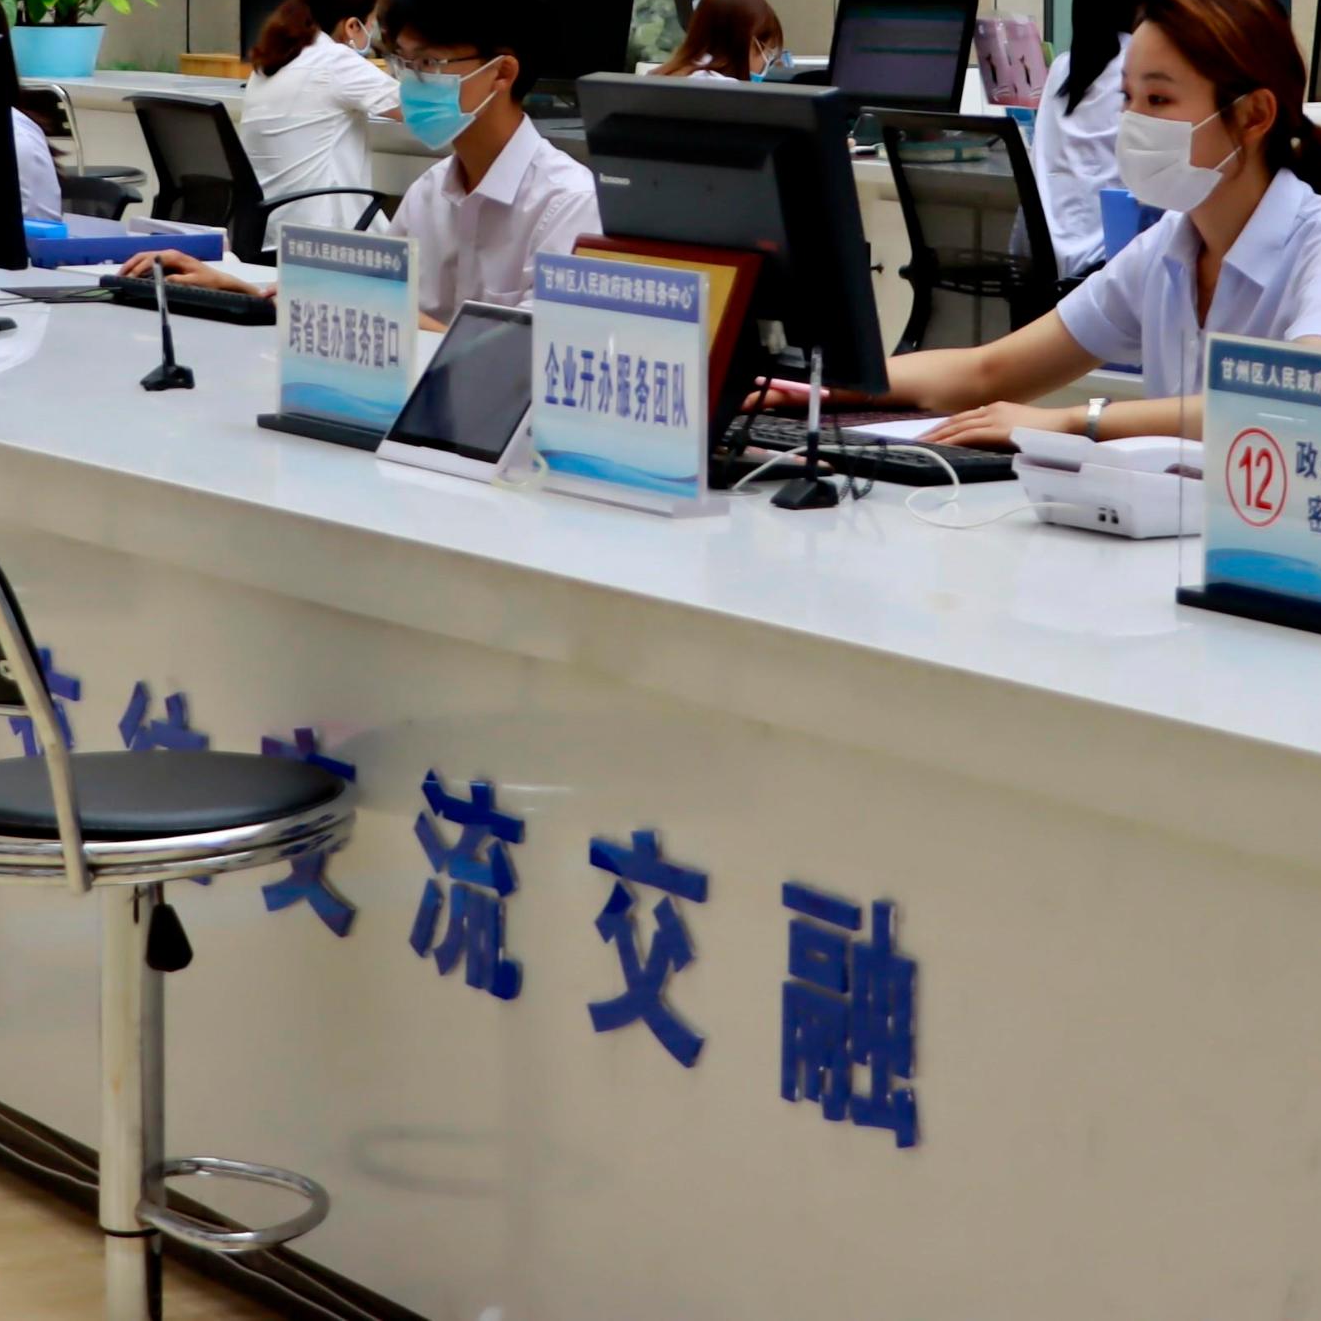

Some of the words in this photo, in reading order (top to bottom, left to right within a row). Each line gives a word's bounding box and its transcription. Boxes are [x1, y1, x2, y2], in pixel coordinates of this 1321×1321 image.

[543, 263, 694, 309] 甘州区人民政府政务服务中心
[289, 298, 400, 369] 跨省通办服务窗口
[544, 342, 690, 429] 企业开办服务团队
[1238, 445, 1273, 511] 12
